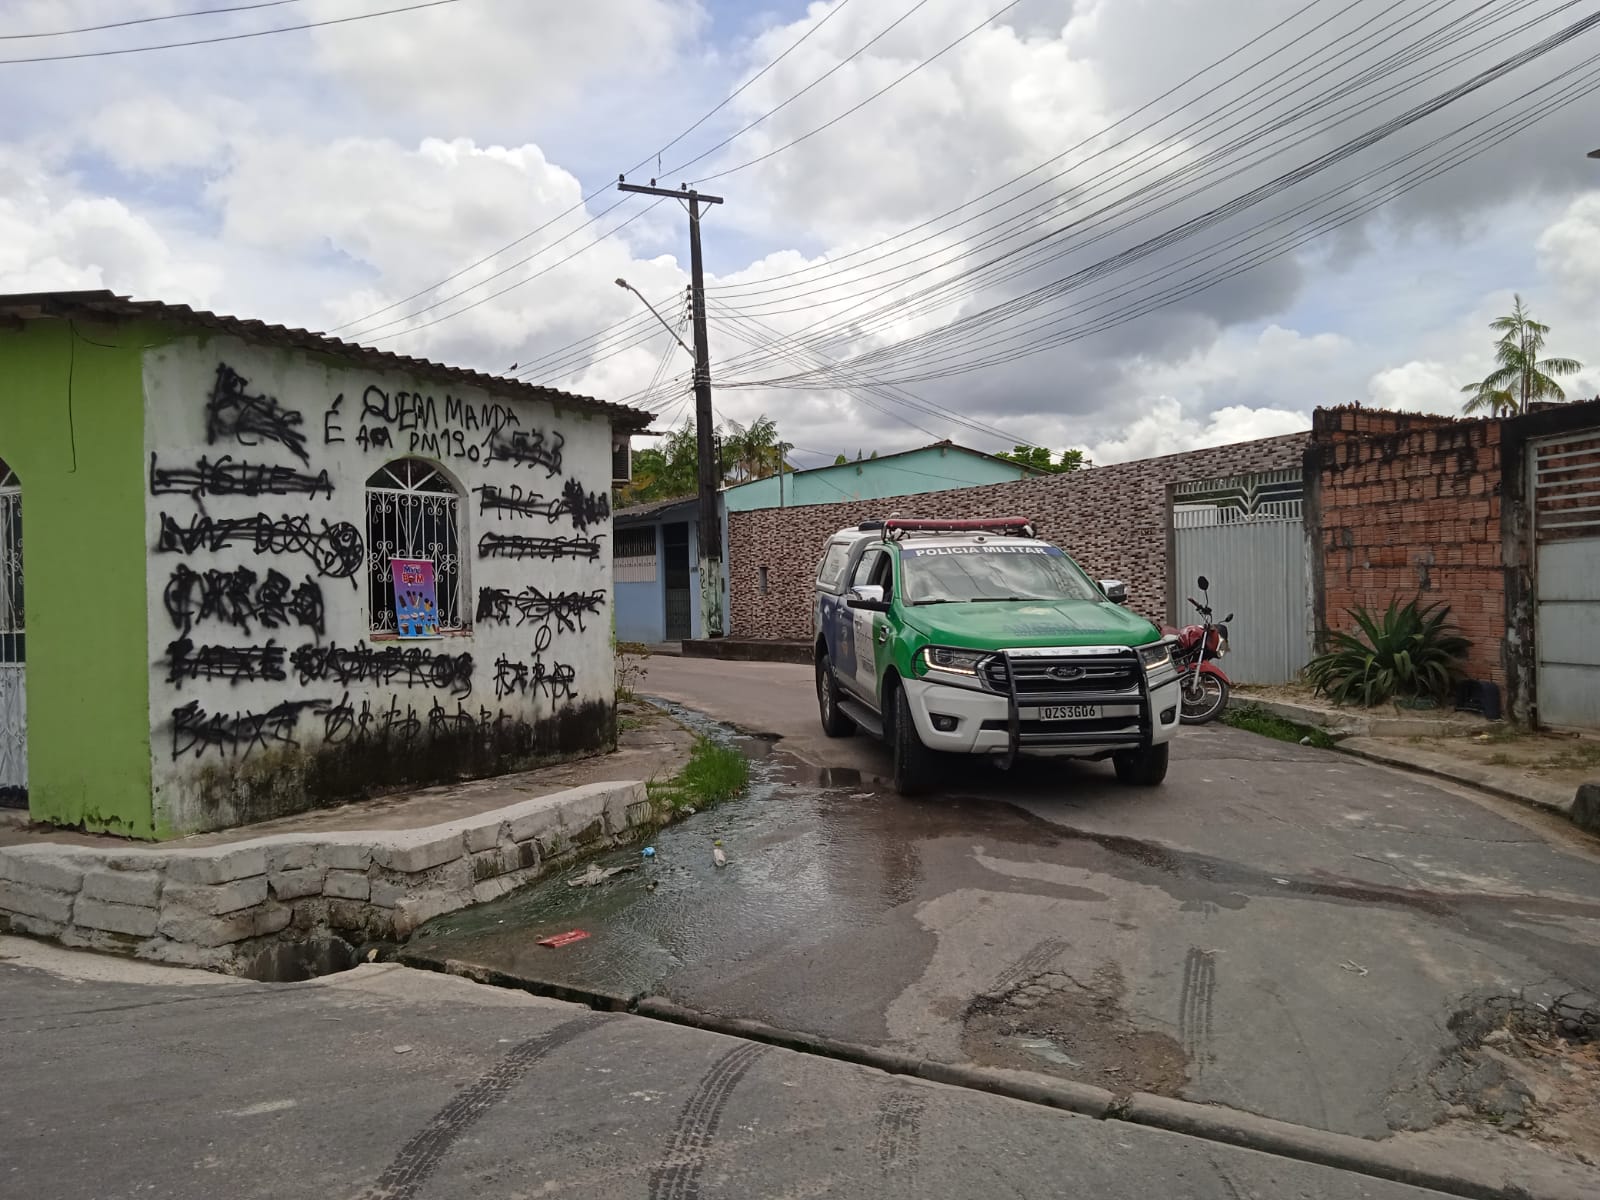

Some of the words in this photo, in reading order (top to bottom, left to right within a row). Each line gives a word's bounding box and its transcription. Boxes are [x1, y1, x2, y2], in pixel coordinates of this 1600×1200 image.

[360, 385, 439, 431] QUEM
[445, 394, 520, 433] MANDA
[981, 545, 1048, 555] MILITAR
